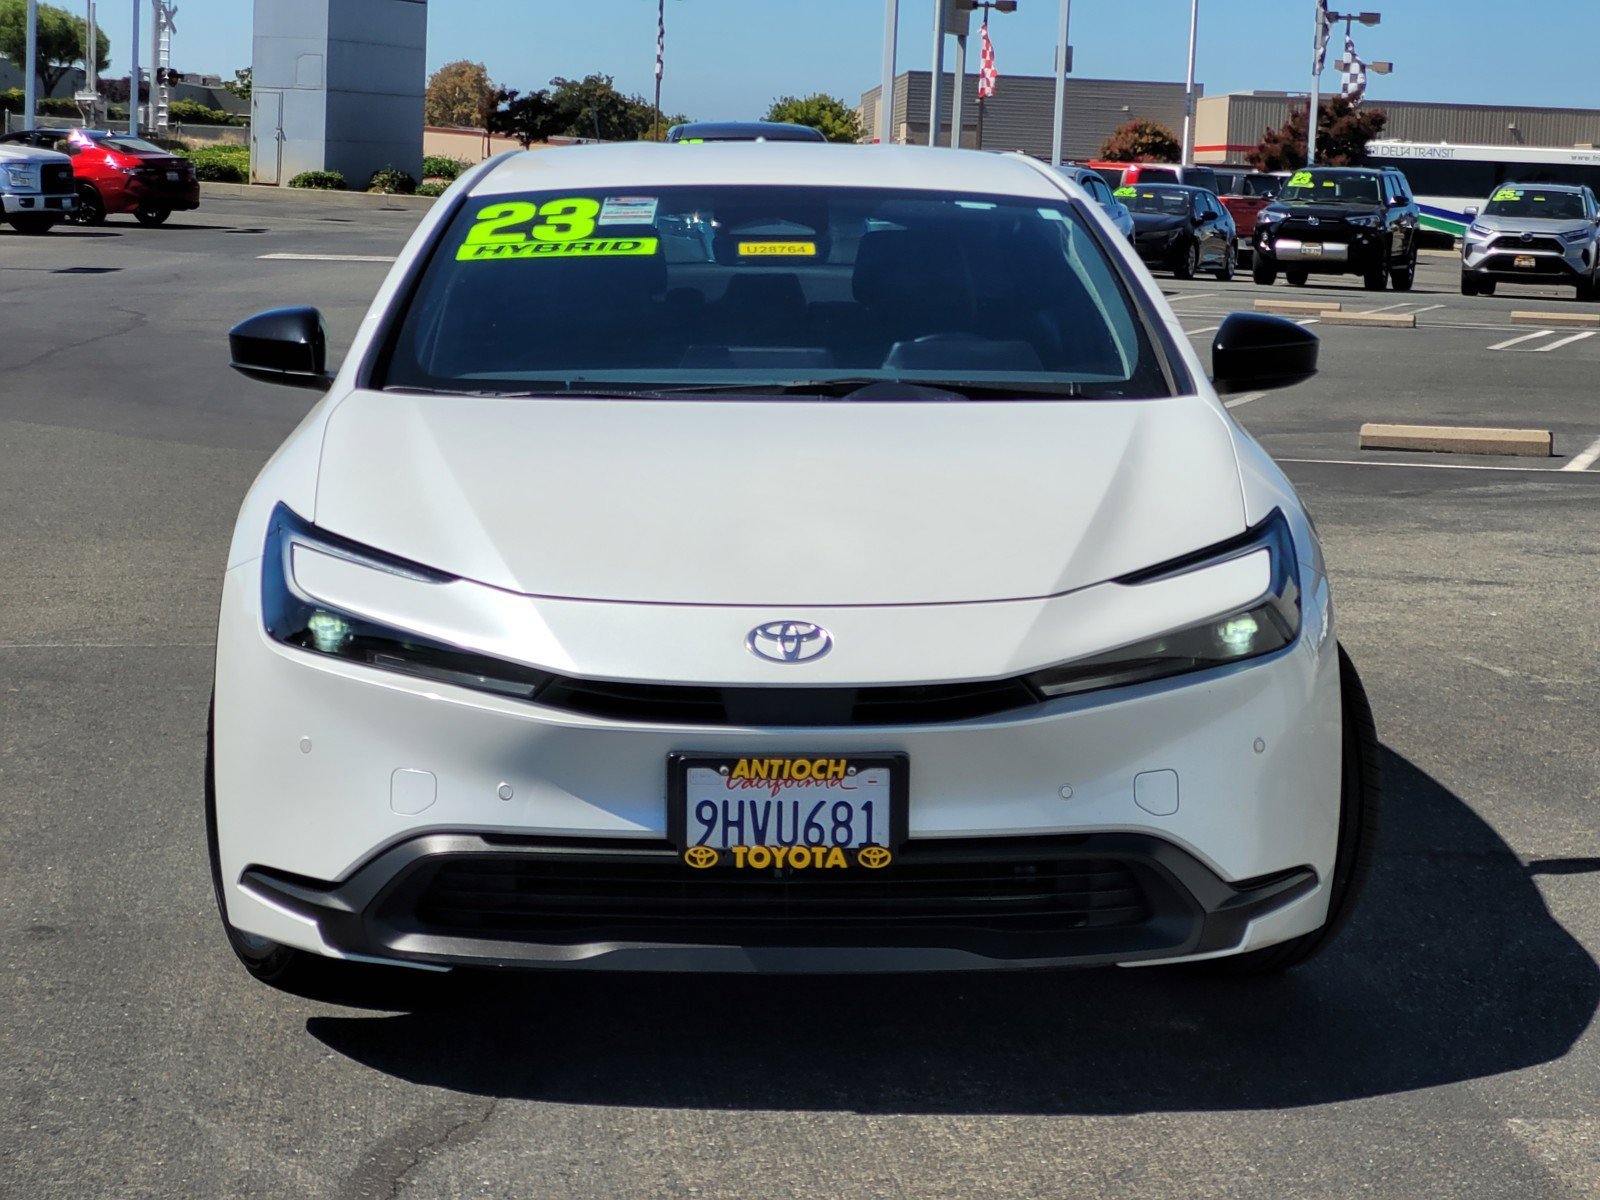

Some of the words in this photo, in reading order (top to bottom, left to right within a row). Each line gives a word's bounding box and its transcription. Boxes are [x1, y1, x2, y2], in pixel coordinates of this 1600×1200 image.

[1381, 146, 1411, 157] DELTA
[1413, 147, 1455, 158] TRANSIT
[464, 198, 600, 244] 23
[473, 241, 648, 256] HYBRID
[746, 245, 806, 254] U28764
[732, 759, 847, 780] ANTIOCH
[695, 800, 881, 848] 9HVU681
[732, 846, 848, 869] TOYOTA
